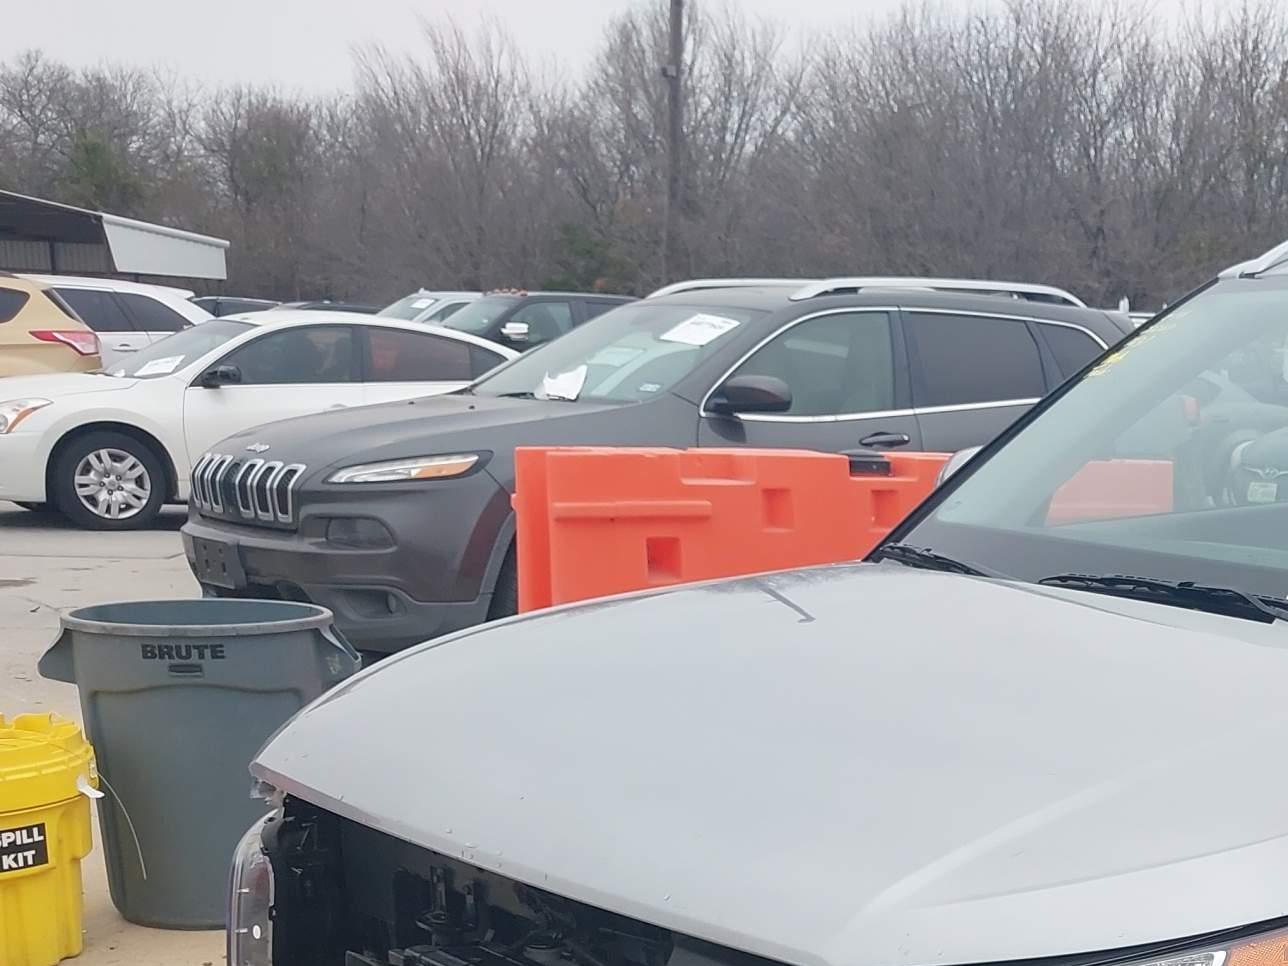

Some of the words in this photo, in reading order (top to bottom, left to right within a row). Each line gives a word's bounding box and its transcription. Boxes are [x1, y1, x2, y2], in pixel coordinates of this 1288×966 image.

[141, 644, 226, 659] BRUTE
[0, 827, 45, 848] PILL
[2, 850, 36, 869] KIT
